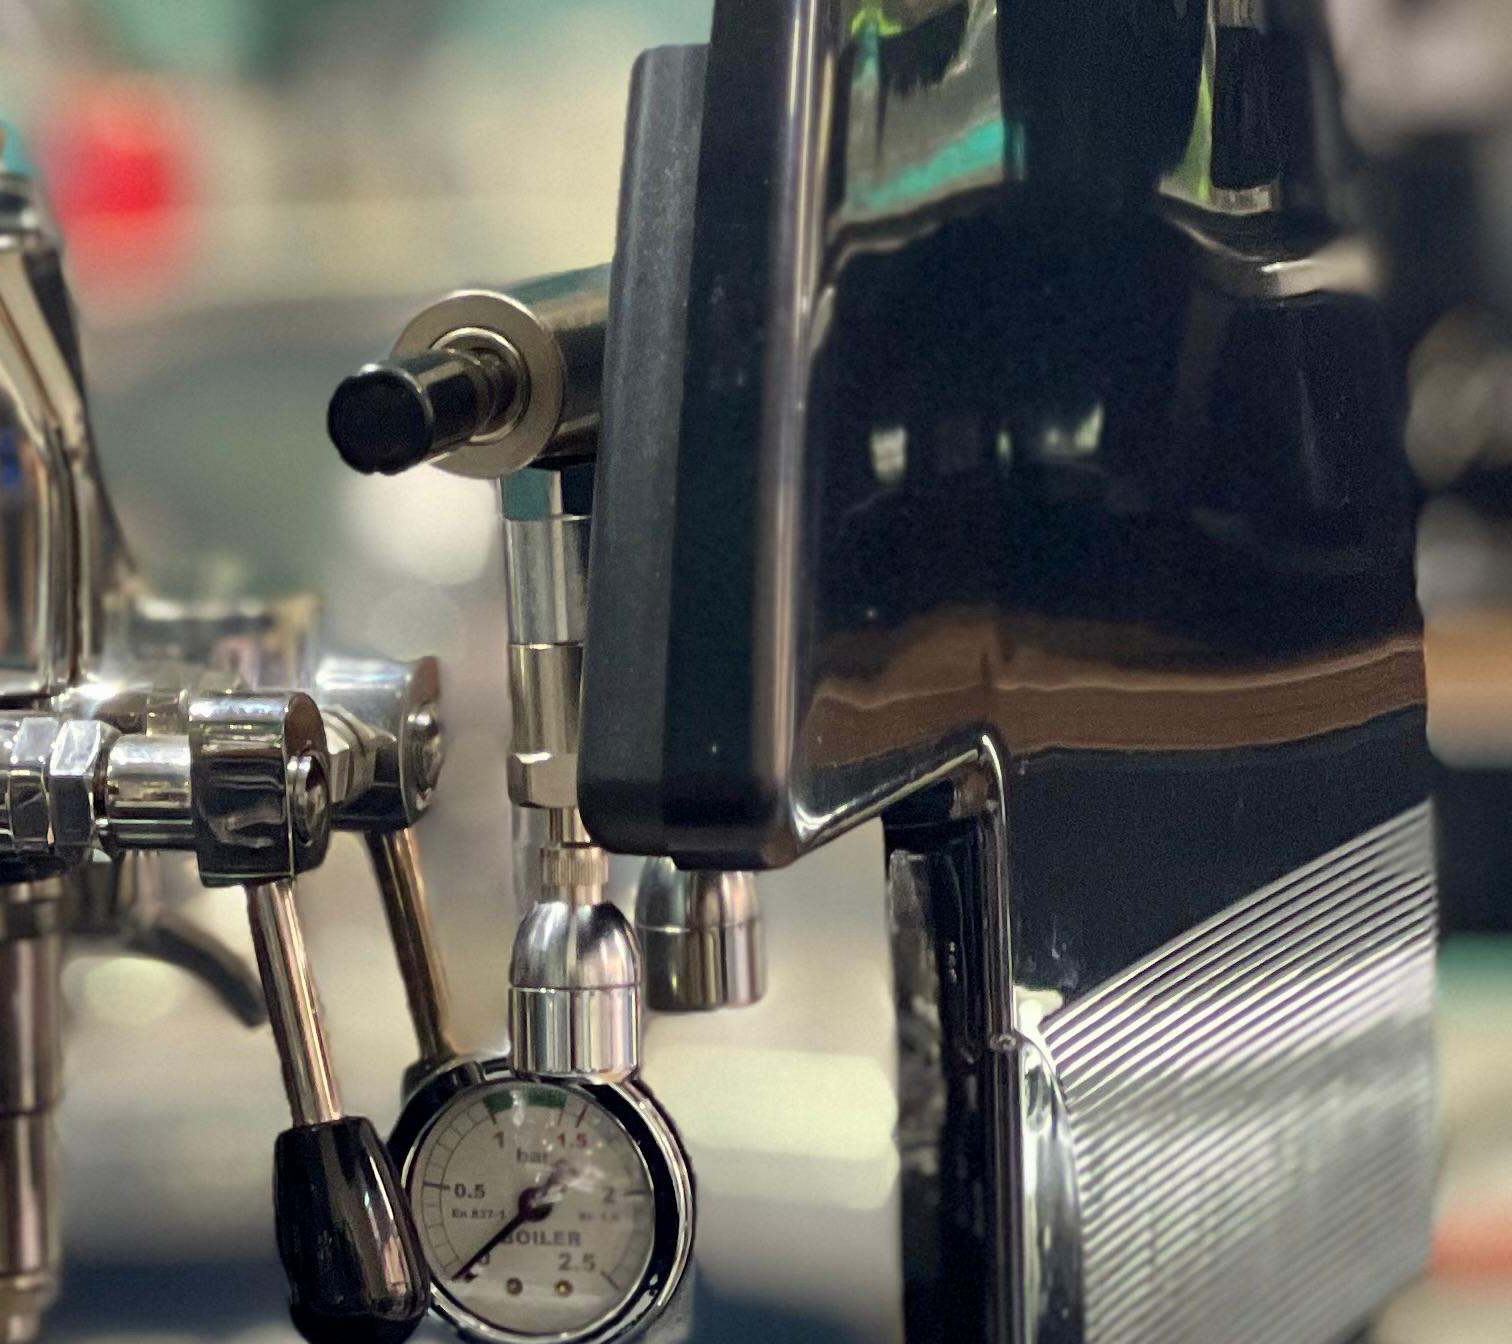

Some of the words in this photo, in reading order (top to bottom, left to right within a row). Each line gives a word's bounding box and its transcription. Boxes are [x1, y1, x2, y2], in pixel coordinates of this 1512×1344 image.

[494, 1130, 505, 1148] 1
[556, 1131, 587, 1148] 1.5
[516, 1147, 549, 1163] bar
[454, 1183, 486, 1199] 0.5
[602, 1186, 616, 1205] 2
[557, 1253, 596, 1272] 2.5
